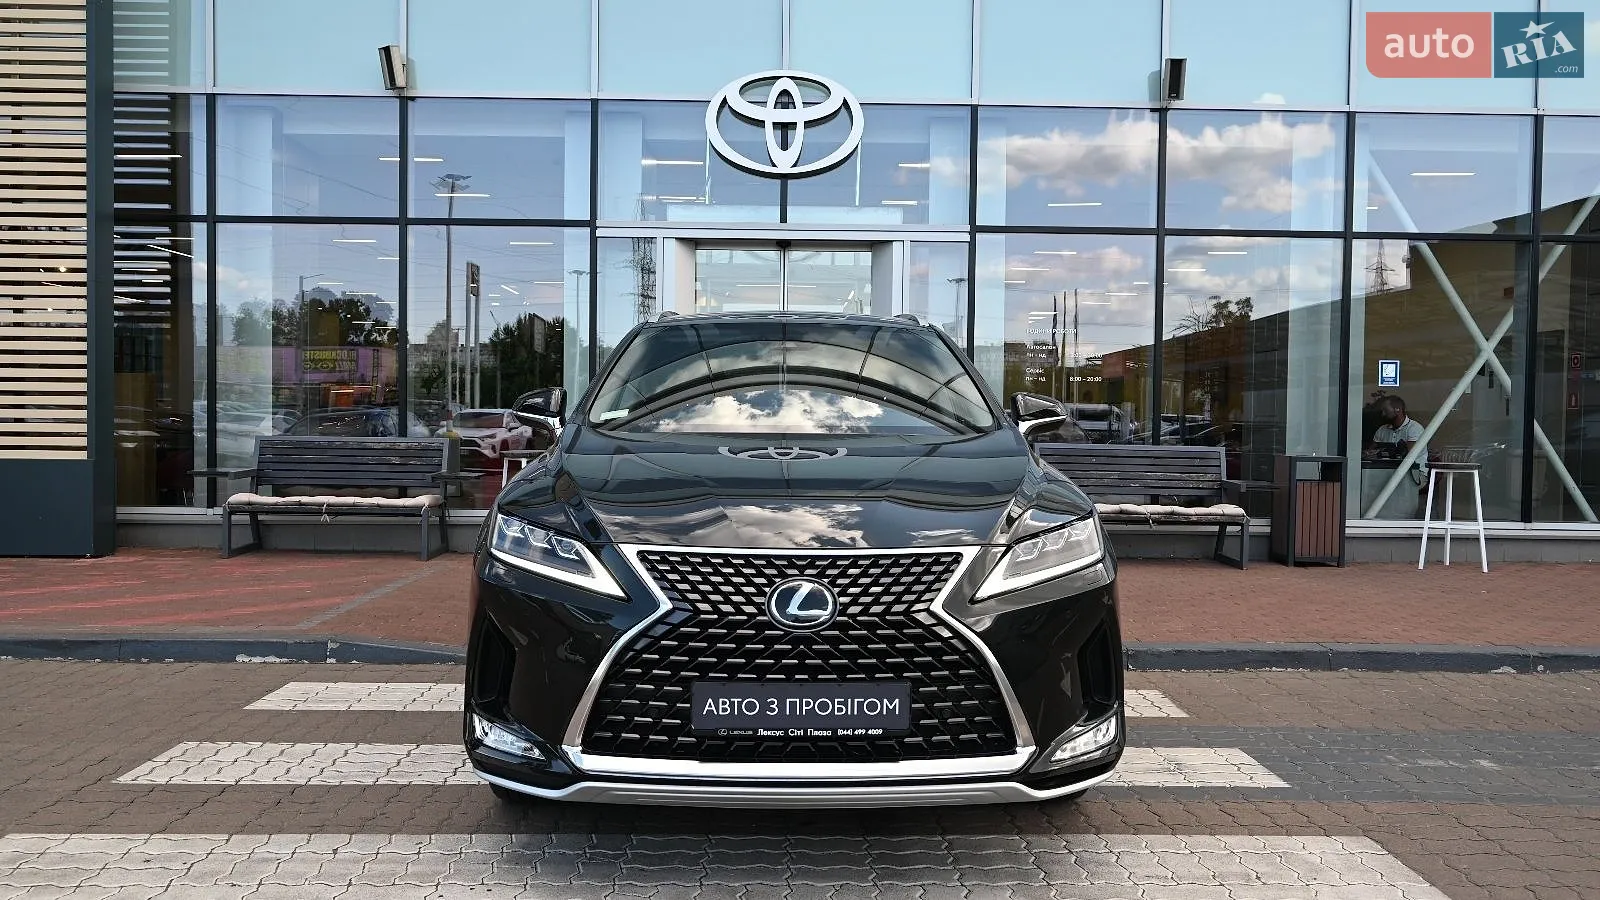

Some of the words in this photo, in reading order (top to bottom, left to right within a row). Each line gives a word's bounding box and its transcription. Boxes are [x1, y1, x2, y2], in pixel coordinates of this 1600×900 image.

[702, 698, 760, 716] АВТО
[786, 698, 900, 716] ПРОБІГОМ
[757, 728, 784, 736] Лексус
[788, 728, 803, 736] Сіті
[807, 728, 832, 736] Плаза
[837, 728, 853, 736] (044)
